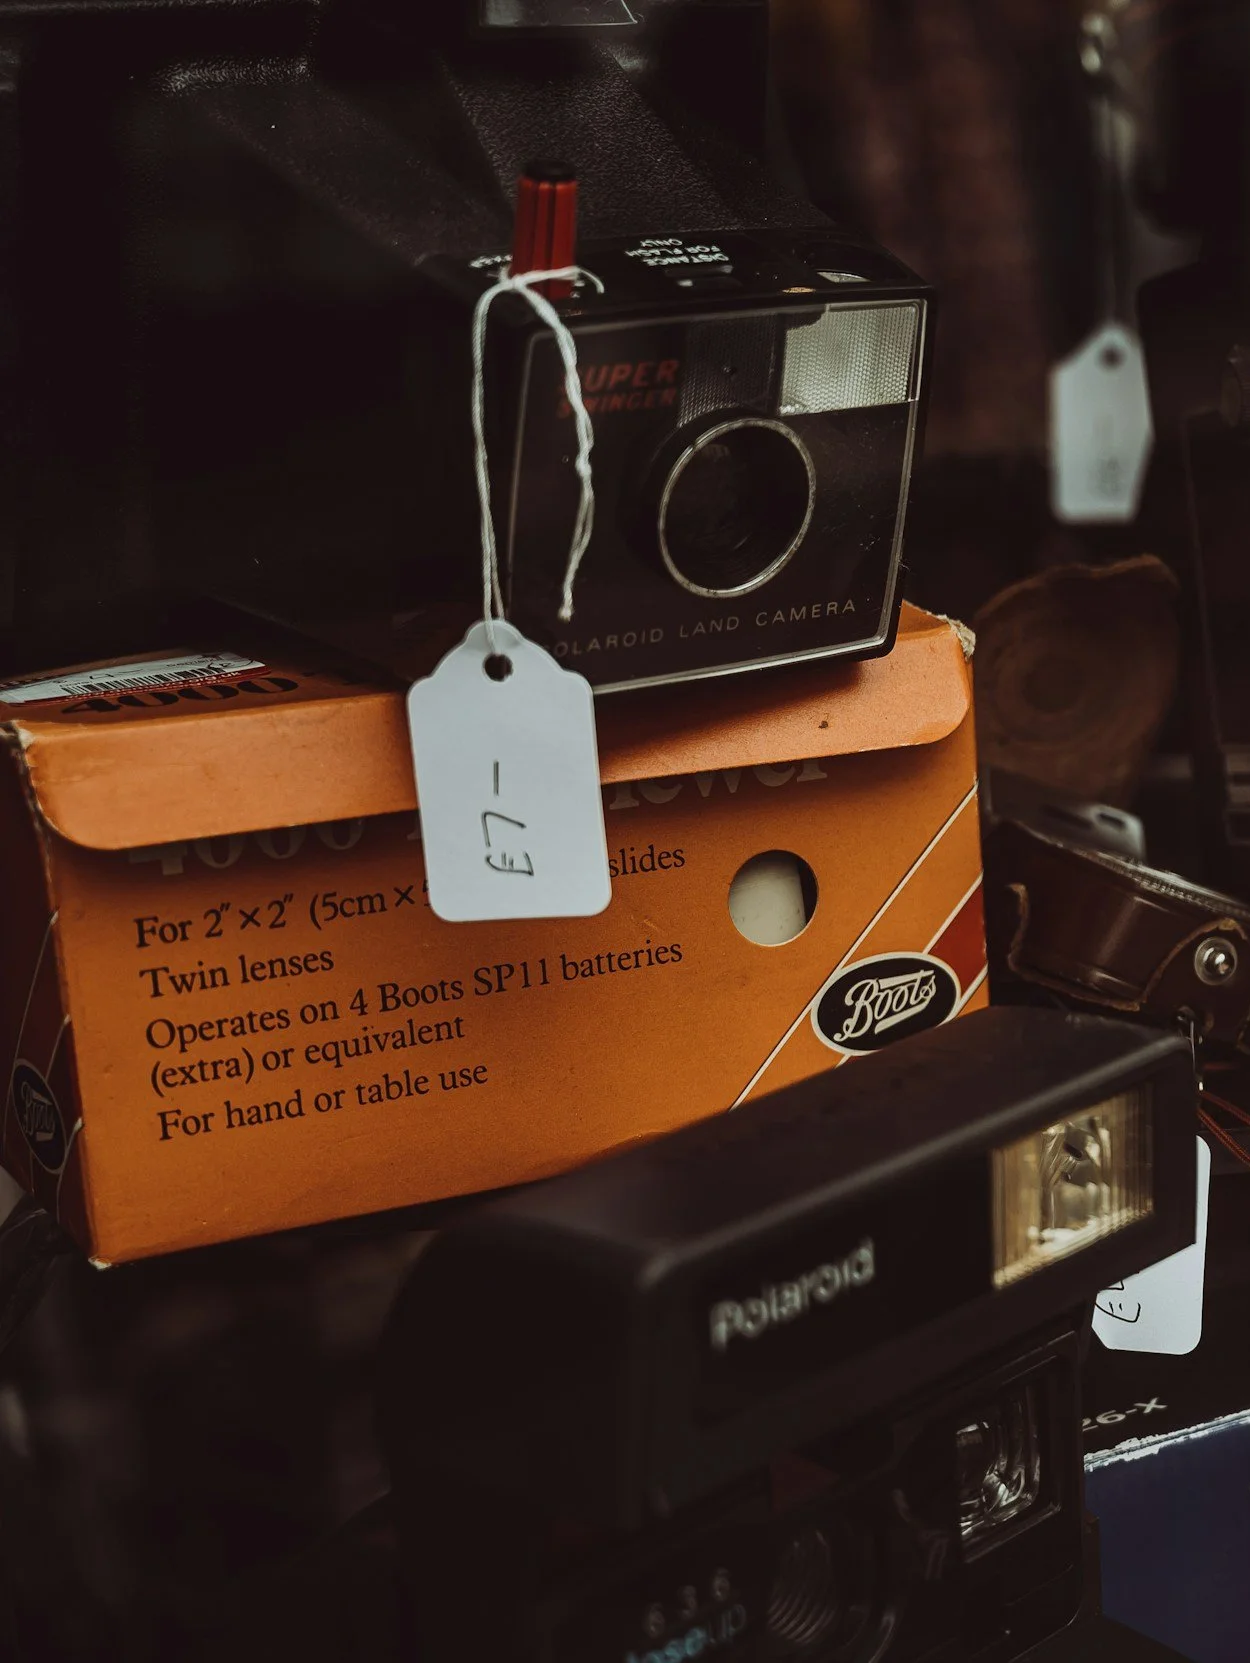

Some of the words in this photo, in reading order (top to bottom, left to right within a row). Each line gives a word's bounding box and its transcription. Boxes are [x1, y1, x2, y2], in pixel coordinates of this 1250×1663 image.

[624, 247, 683, 257] FLASH
[640, 238, 683, 247] ONLY
[642, 252, 730, 266] DISTANCE
[685, 245, 720, 254] FOR
[547, 628, 664, 658] OLAROID
[679, 616, 741, 638] LAND
[755, 599, 857, 627] CAMERA
[61, 677, 299, 714] 4000
[133, 915, 193, 948] For
[608, 843, 687, 878] slides
[139, 960, 231, 998] Twin
[238, 950, 335, 985] lenses
[146, 1008, 291, 1054] Operates
[299, 1000, 340, 1025] on
[349, 988, 369, 1016] 4
[377, 979, 465, 1013] Boots
[473, 958, 550, 996] SP11
[560, 939, 684, 981] batteries
[833, 969, 937, 1042] Boots
[151, 1047, 255, 1098] (extra)
[261, 1047, 295, 1072] or
[304, 1016, 466, 1068] equivalent
[157, 1108, 215, 1141] For
[224, 1089, 306, 1129] hand
[313, 1089, 345, 1113] or
[355, 1069, 430, 1106] table
[438, 1064, 489, 1091] use
[709, 1235, 876, 1352] Polaroid
